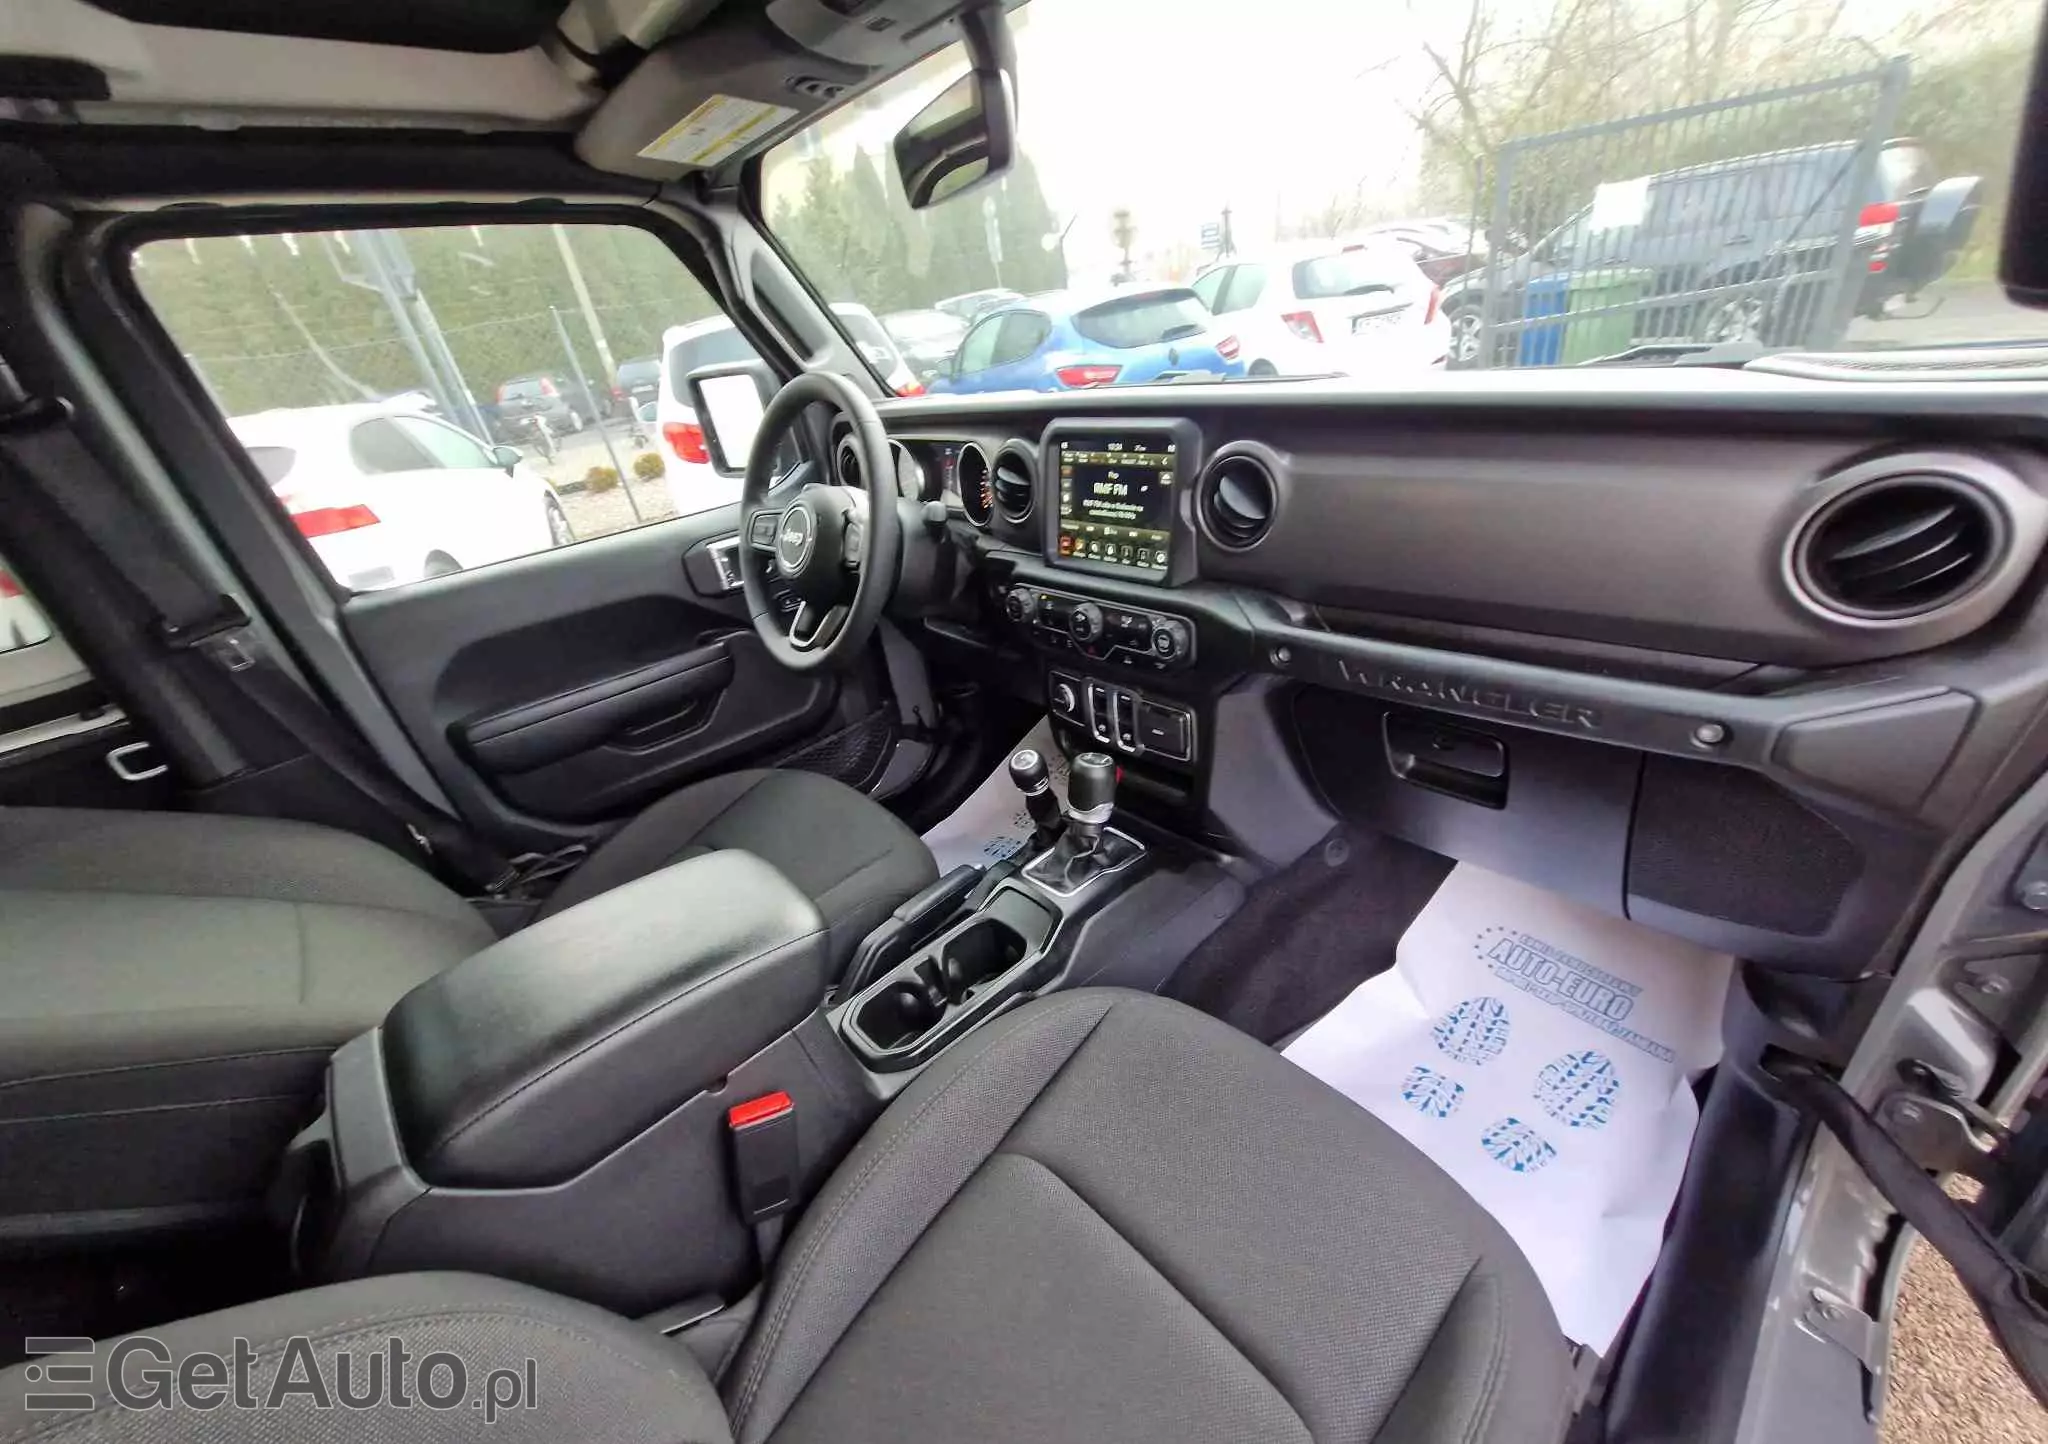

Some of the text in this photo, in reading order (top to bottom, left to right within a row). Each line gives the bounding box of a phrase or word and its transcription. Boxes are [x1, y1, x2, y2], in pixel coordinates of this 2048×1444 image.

[1113, 483, 1128, 496] FM
[1337, 659, 1596, 729] WRANGLER
[1487, 937, 1635, 1022] AUTO-EURO
